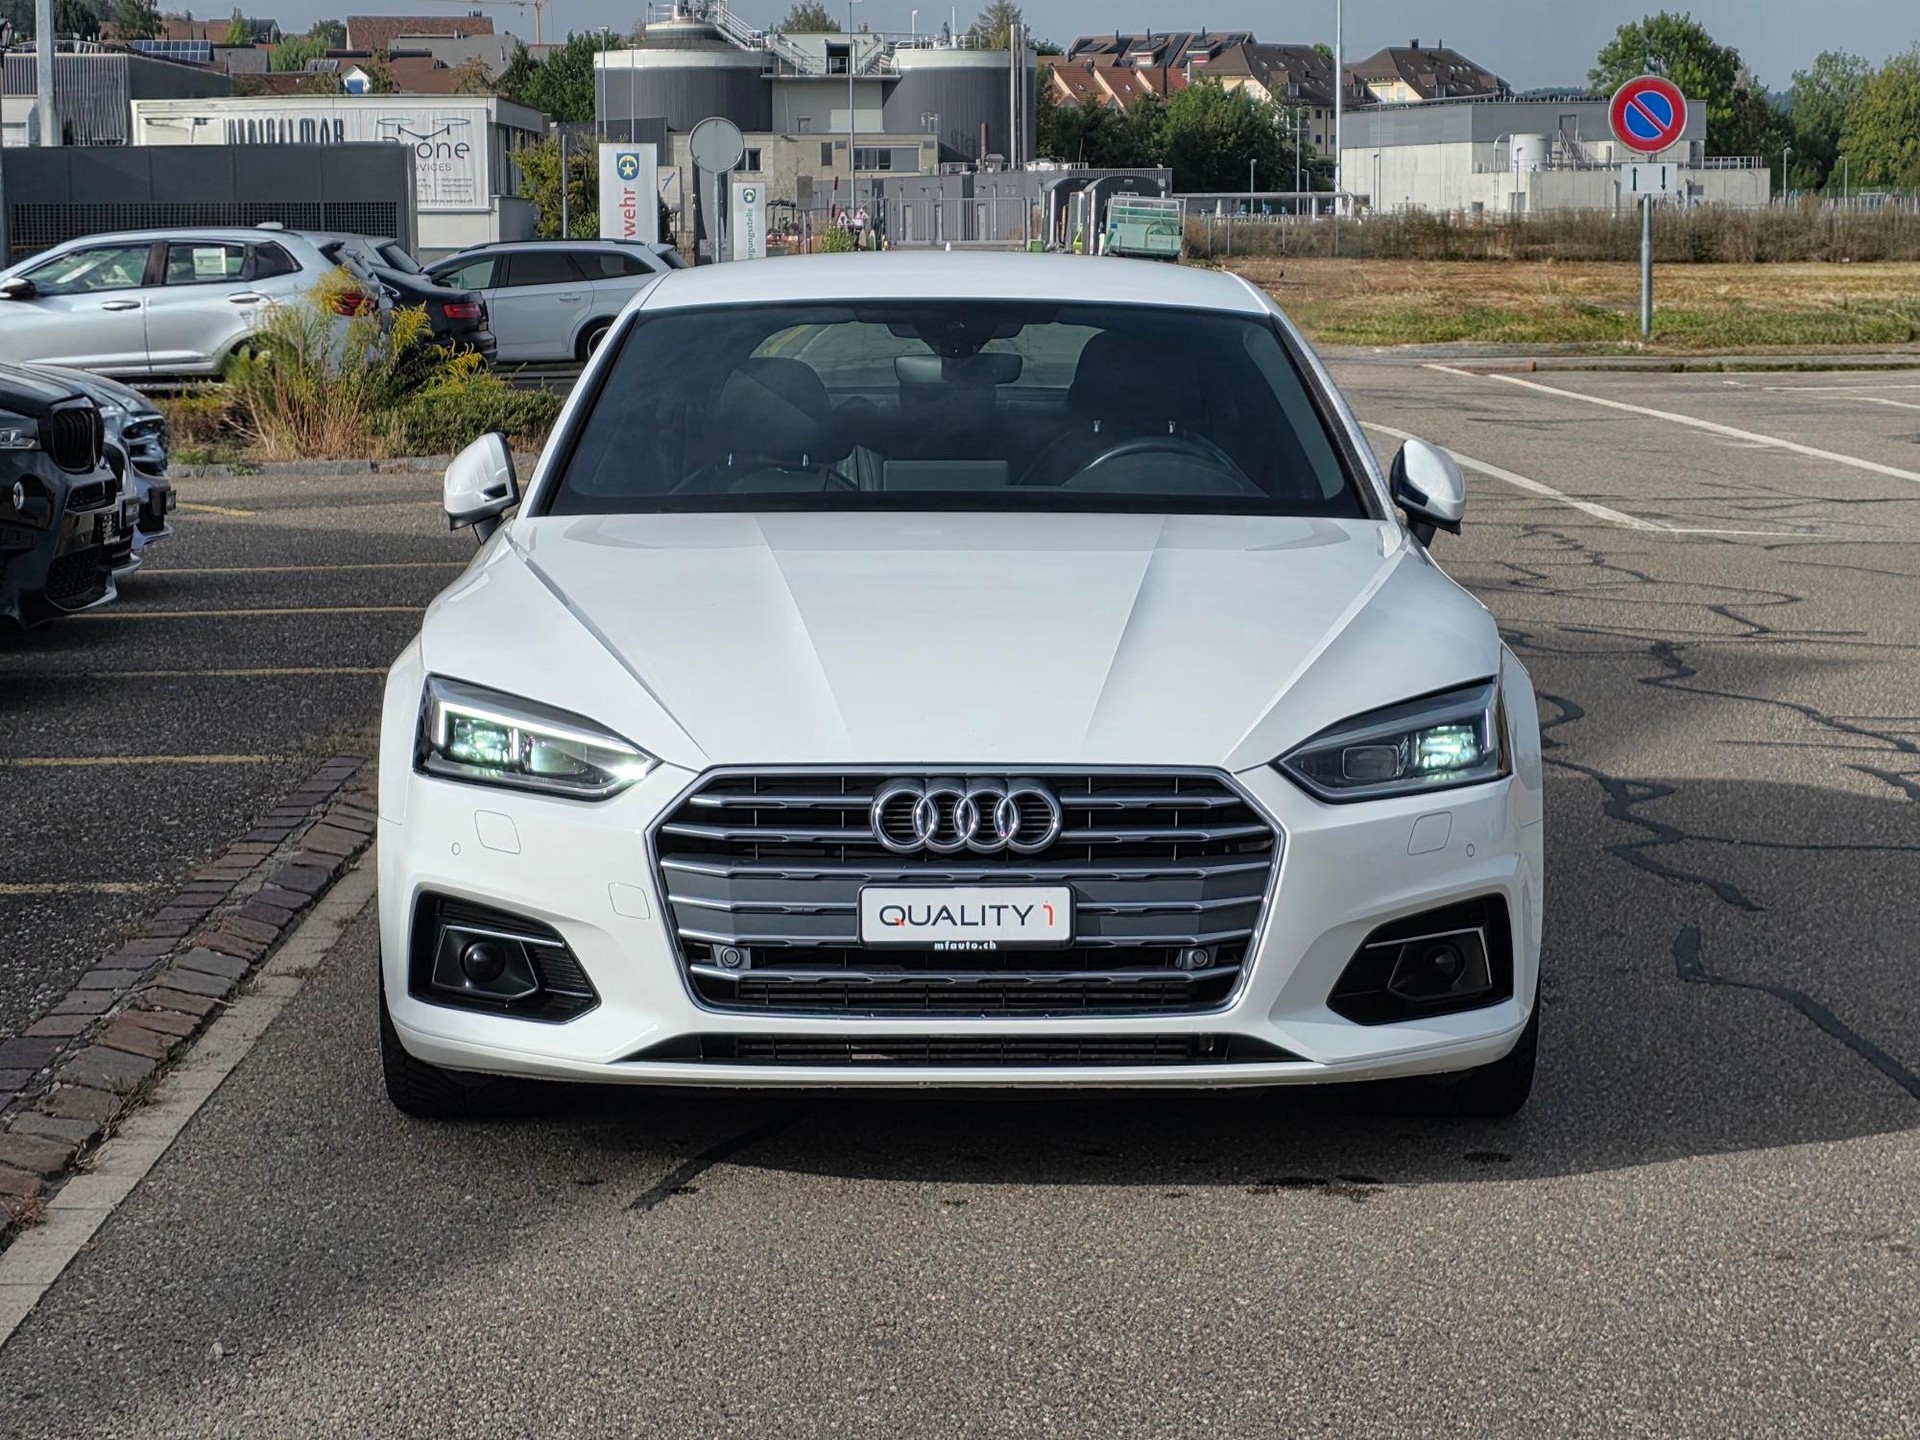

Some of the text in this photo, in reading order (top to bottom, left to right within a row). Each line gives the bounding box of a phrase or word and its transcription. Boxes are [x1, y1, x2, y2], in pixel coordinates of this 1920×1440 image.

[619, 188, 636, 238] wehr
[879, 905, 1054, 926] QUALITY 1
[934, 941, 997, 950] mfauto.ch
